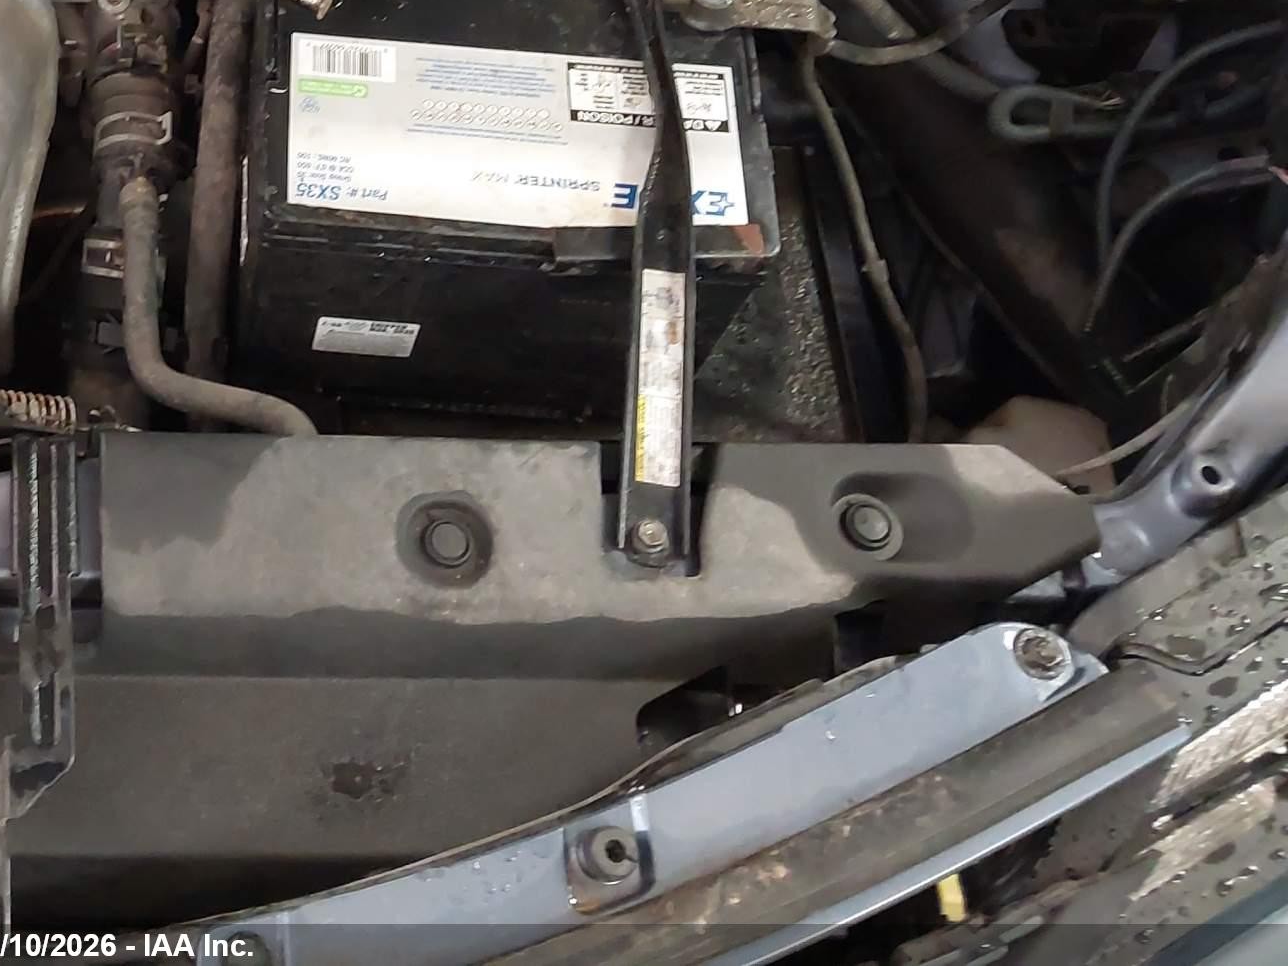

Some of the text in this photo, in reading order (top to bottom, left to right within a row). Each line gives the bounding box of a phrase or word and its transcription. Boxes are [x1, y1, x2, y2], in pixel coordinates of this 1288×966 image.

[576, 109, 634, 126] POISON
[295, 182, 342, 202] SX35
[516, 174, 602, 192] SPRINTER
[360, 187, 389, 201] Part
[611, 182, 732, 218] EXE
